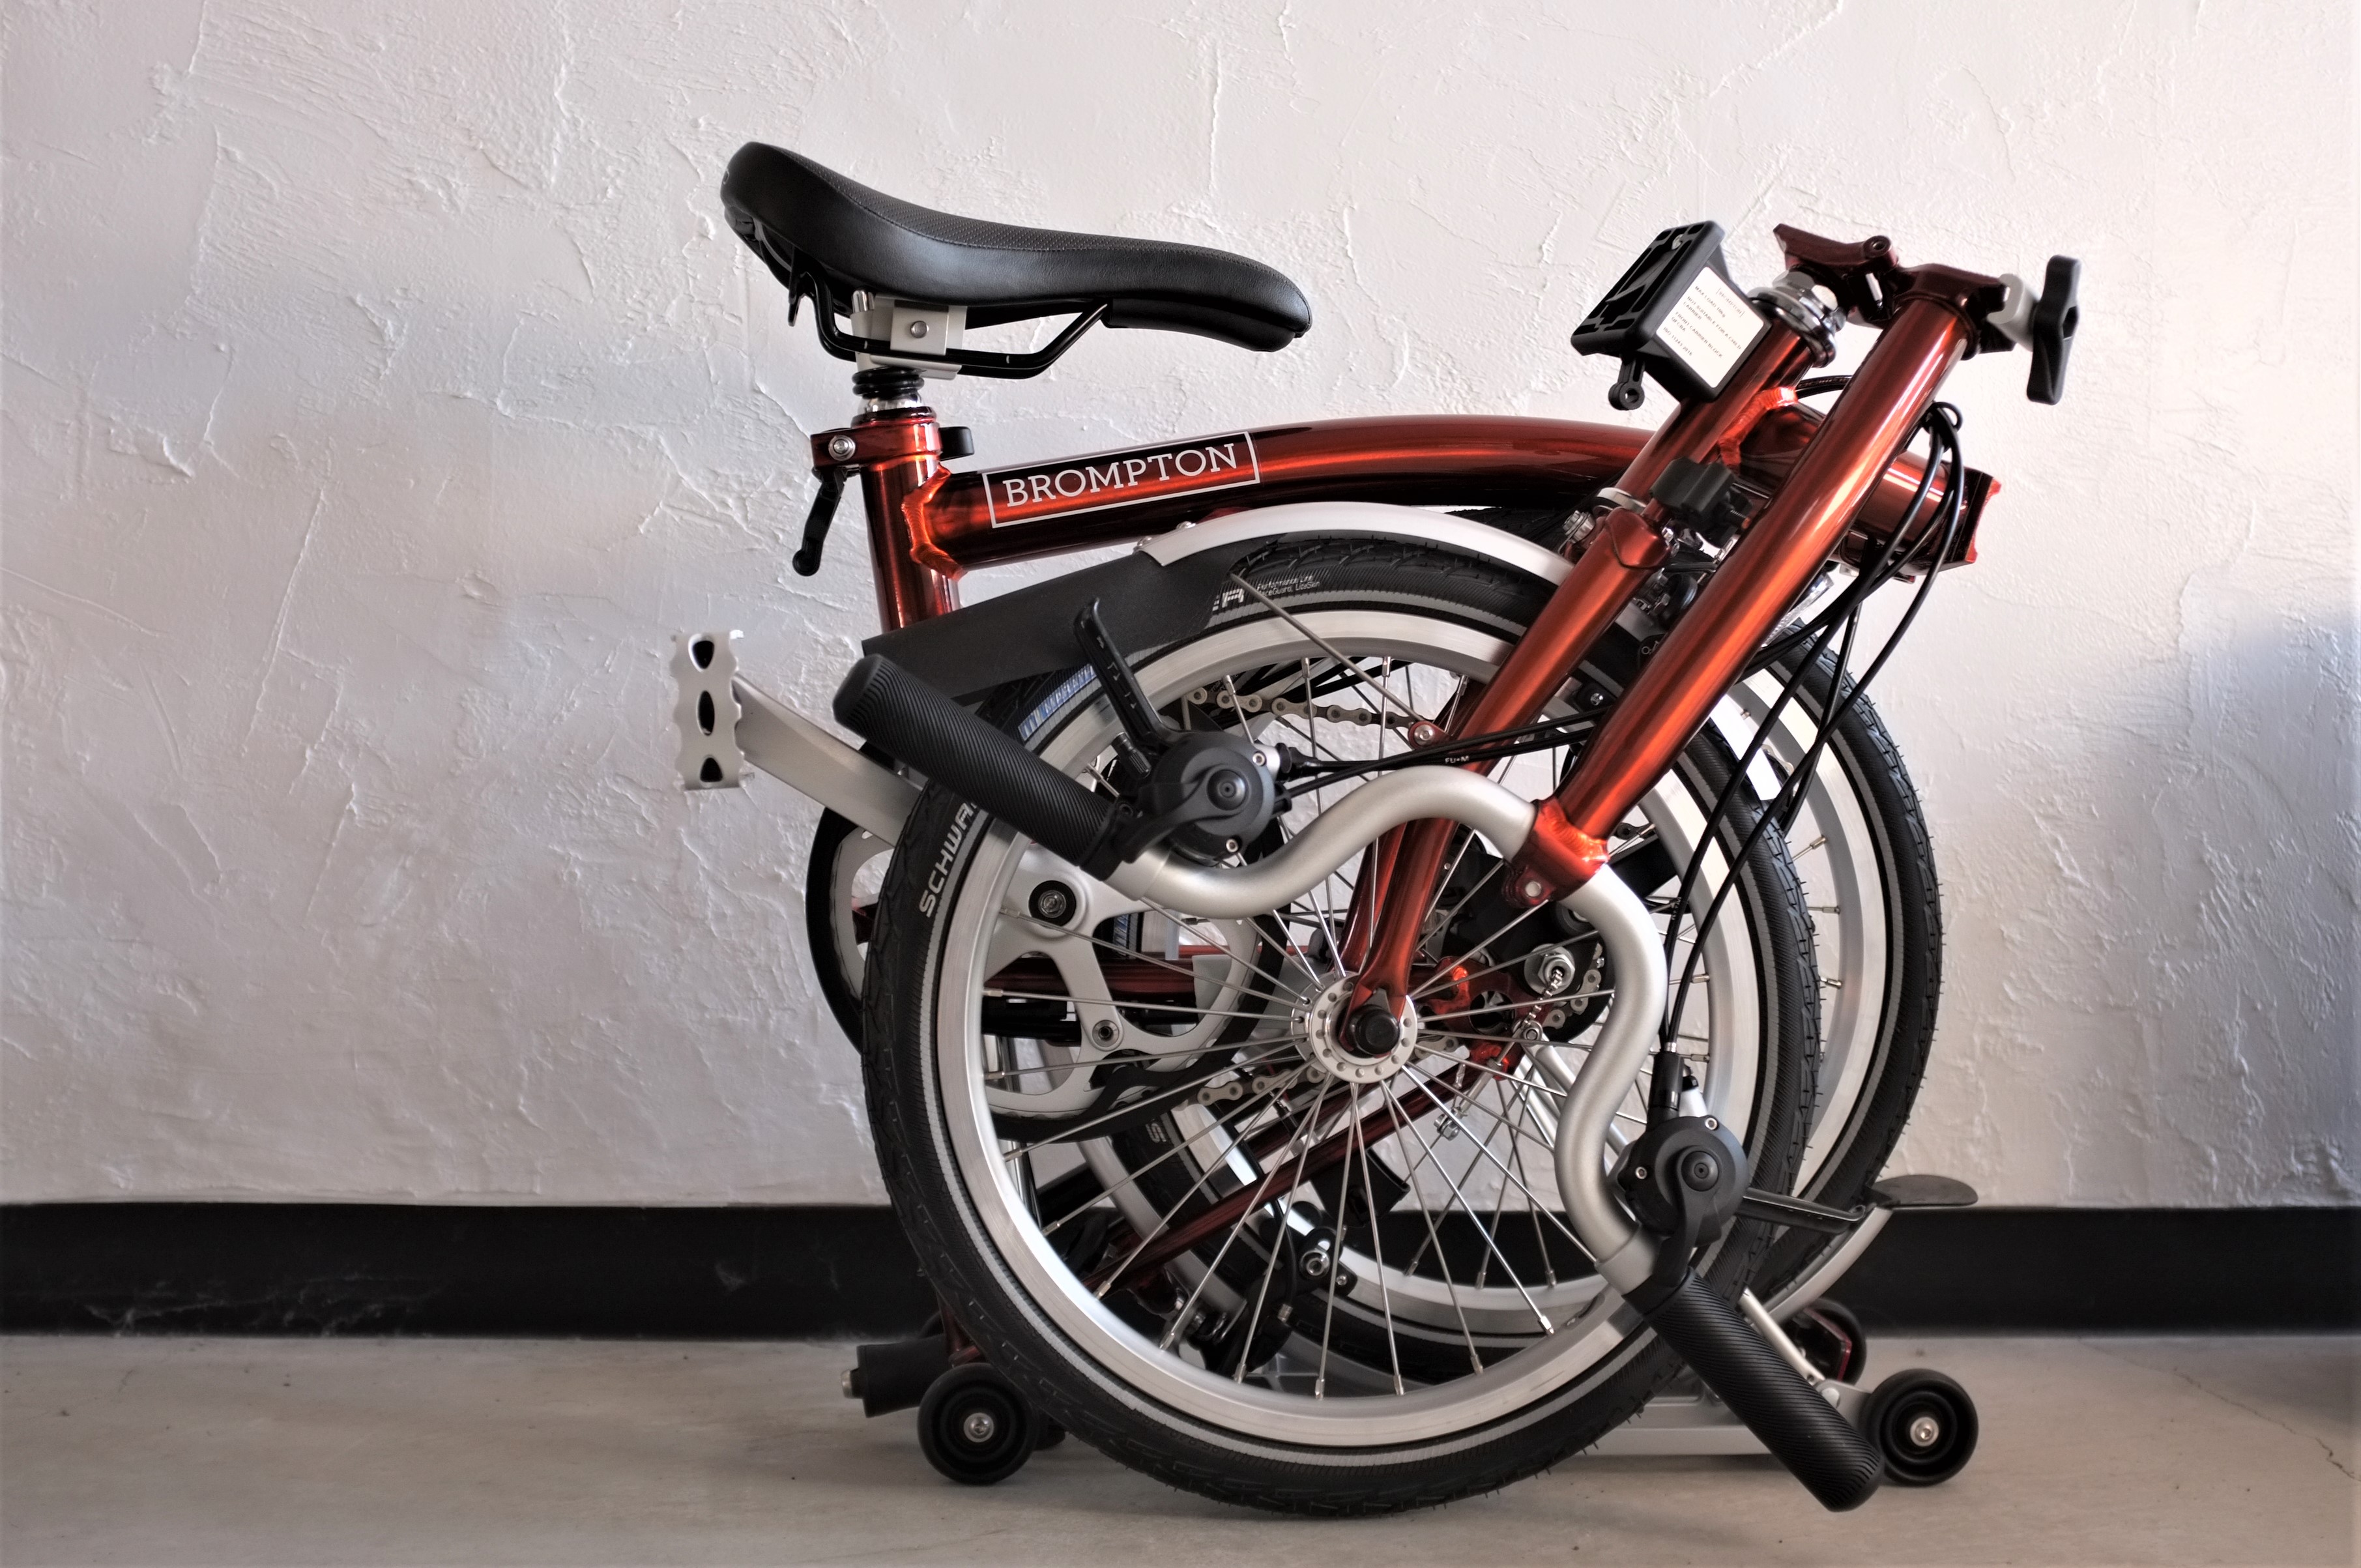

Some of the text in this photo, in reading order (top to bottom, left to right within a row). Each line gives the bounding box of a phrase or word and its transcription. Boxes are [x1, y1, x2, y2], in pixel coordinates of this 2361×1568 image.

[1704, 295, 1716, 308] LOAD
[1002, 443, 1238, 507] BROMPTON
[919, 802, 979, 918] SCHWA
